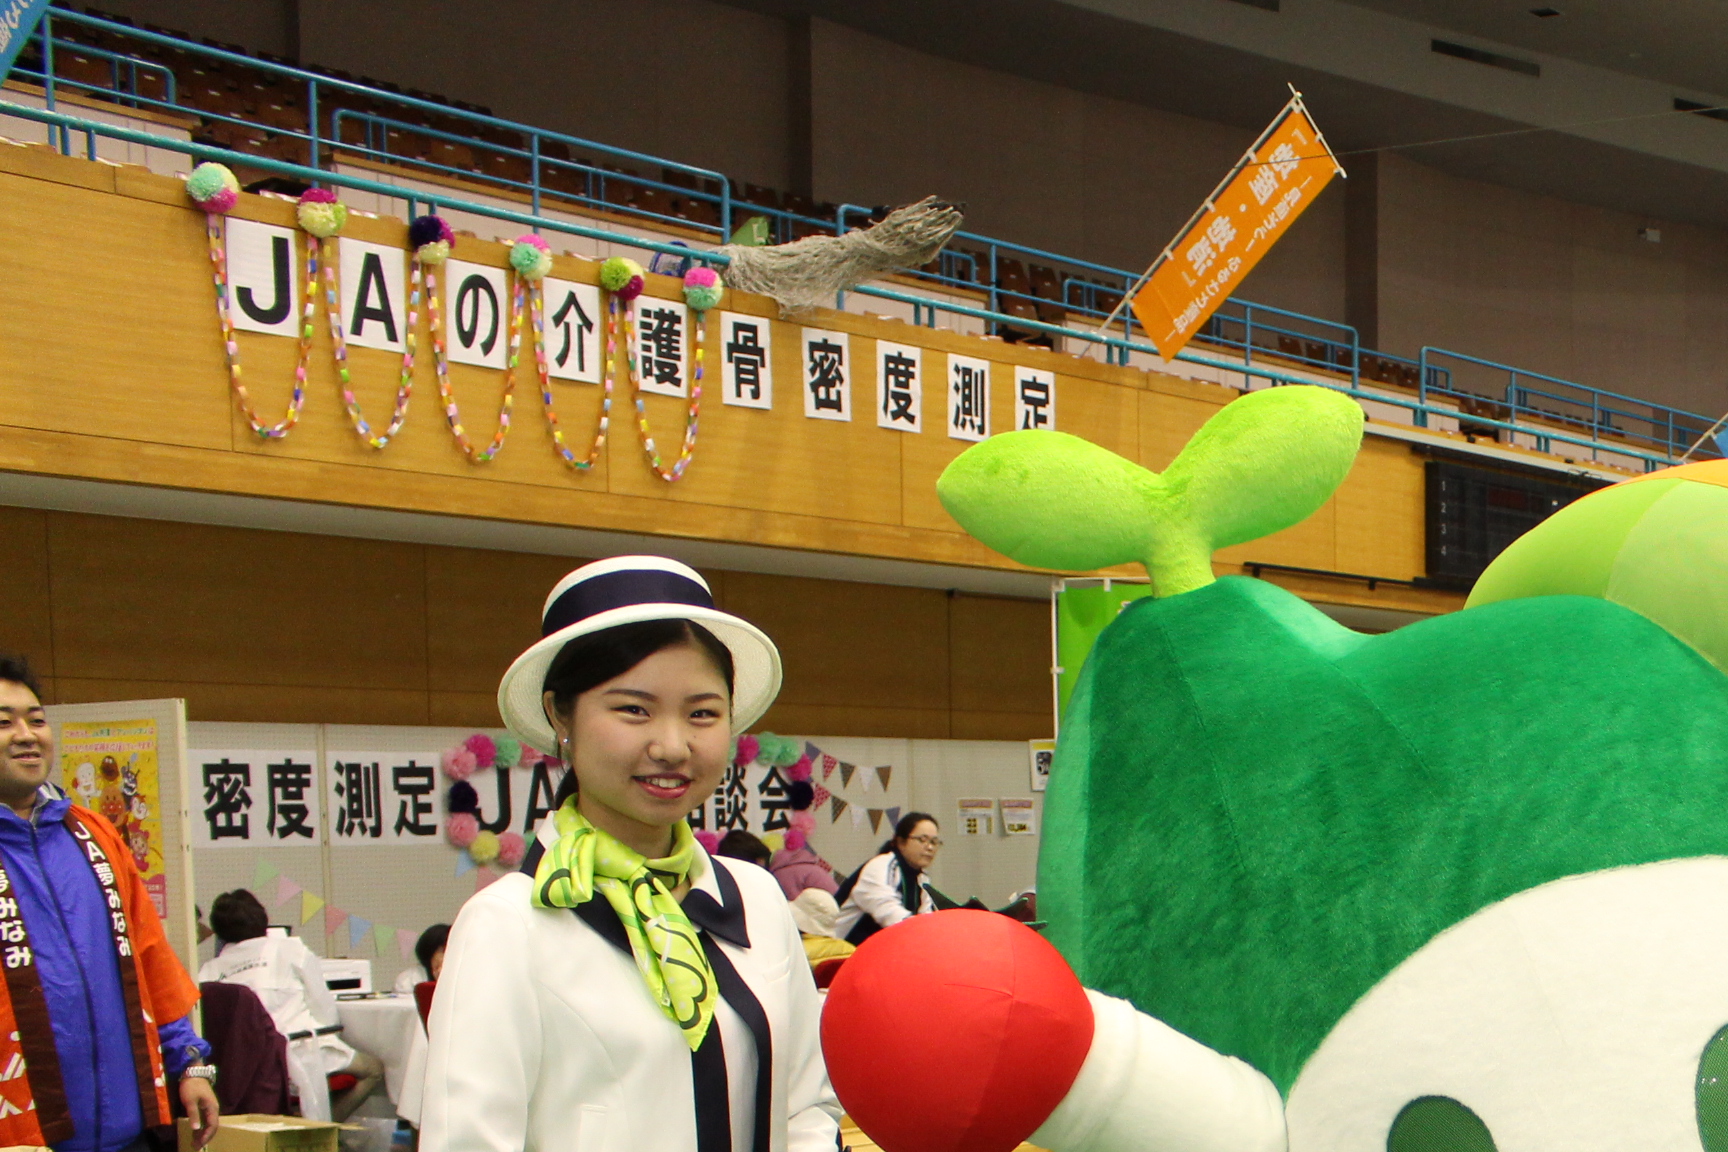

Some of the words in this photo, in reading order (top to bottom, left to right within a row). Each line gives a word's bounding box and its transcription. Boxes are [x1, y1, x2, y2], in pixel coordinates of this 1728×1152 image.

[202, 757, 438, 841] 密度測定
[693, 765, 791, 832] 談会
